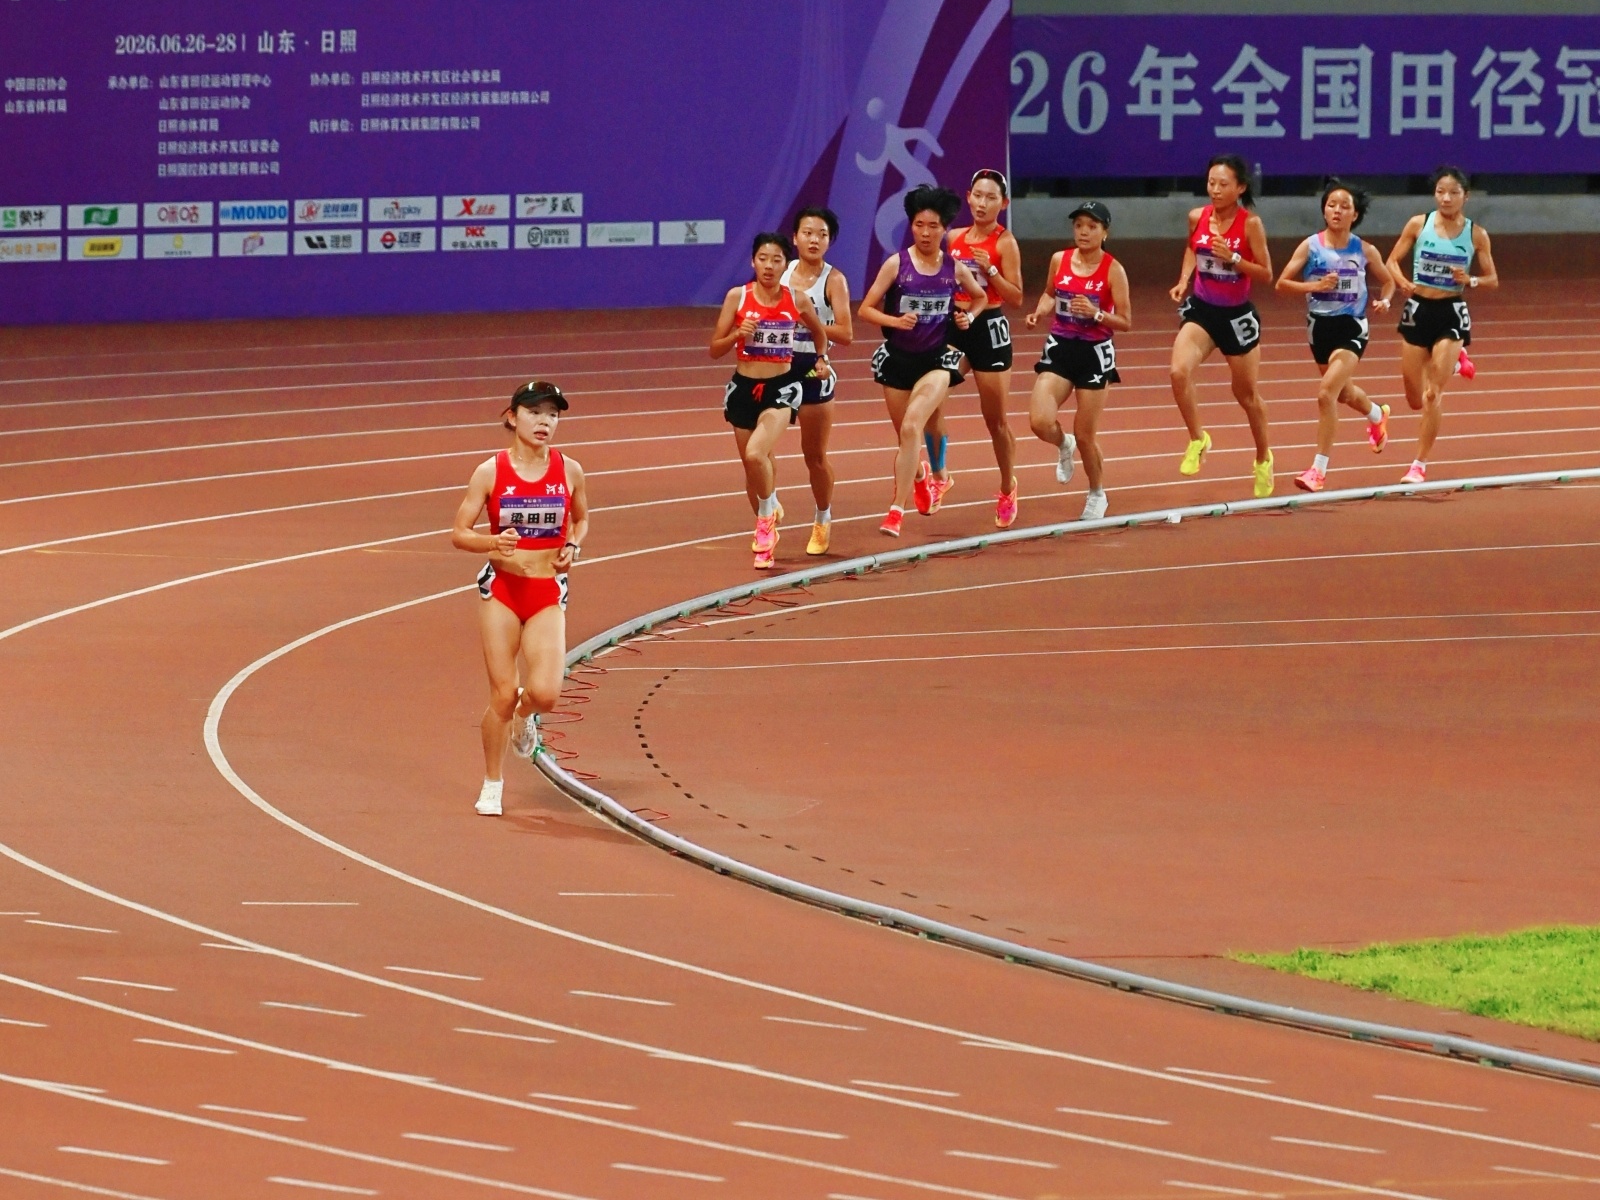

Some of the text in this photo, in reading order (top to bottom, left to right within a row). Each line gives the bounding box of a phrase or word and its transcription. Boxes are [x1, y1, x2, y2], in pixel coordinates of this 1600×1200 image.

[230, 205, 287, 220] MONDO
[465, 226, 486, 237] PICC
[1085, 280, 1104, 292] 北京
[908, 299, 946, 311] 李亚轩
[990, 319, 1009, 345] 10
[1238, 318, 1256, 340] 3
[753, 331, 790, 344] 胡金花
[1101, 344, 1114, 369] 5
[545, 483, 565, 495] 河南
[510, 512, 557, 525] 梁田田
